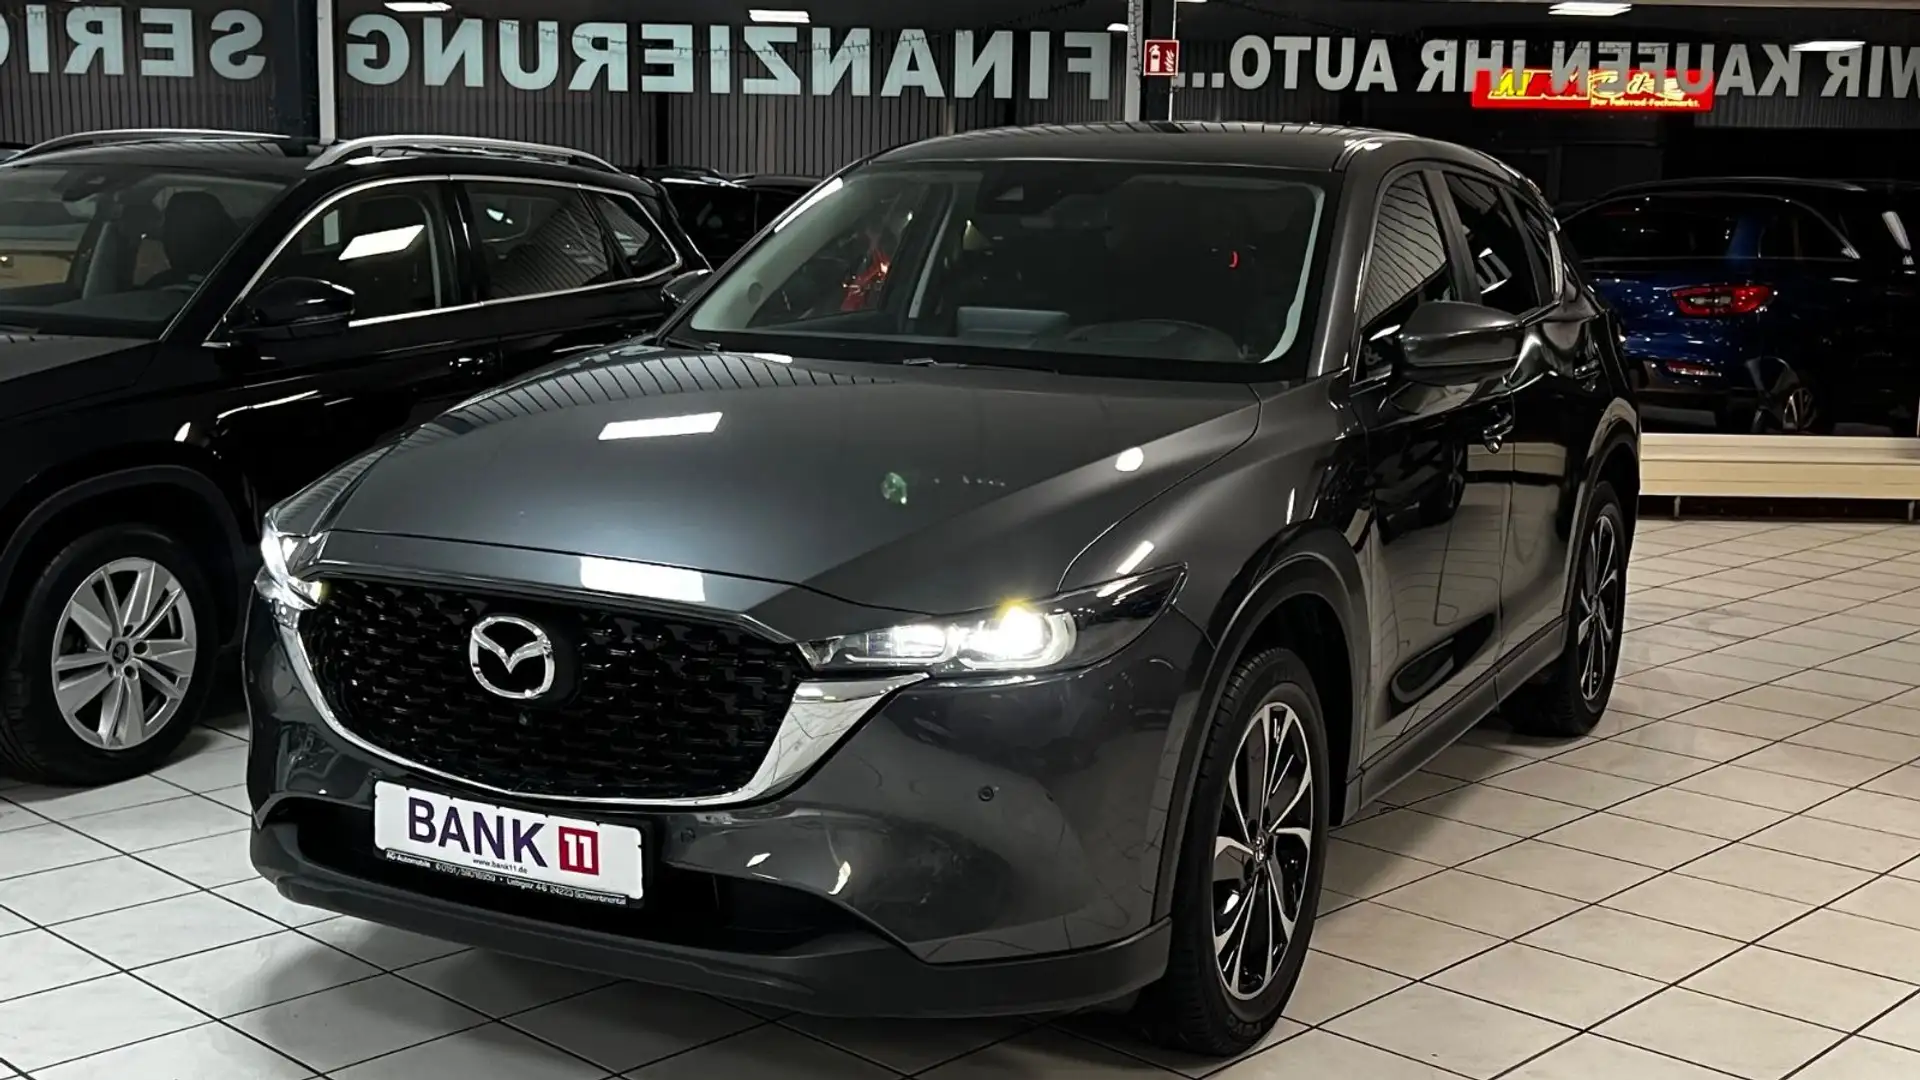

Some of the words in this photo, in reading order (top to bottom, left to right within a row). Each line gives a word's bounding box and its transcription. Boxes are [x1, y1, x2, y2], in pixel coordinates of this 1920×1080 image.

[409, 797, 548, 868] BANK
[563, 833, 594, 869] 11
[472, 858, 528, 875] www.bank11.de
